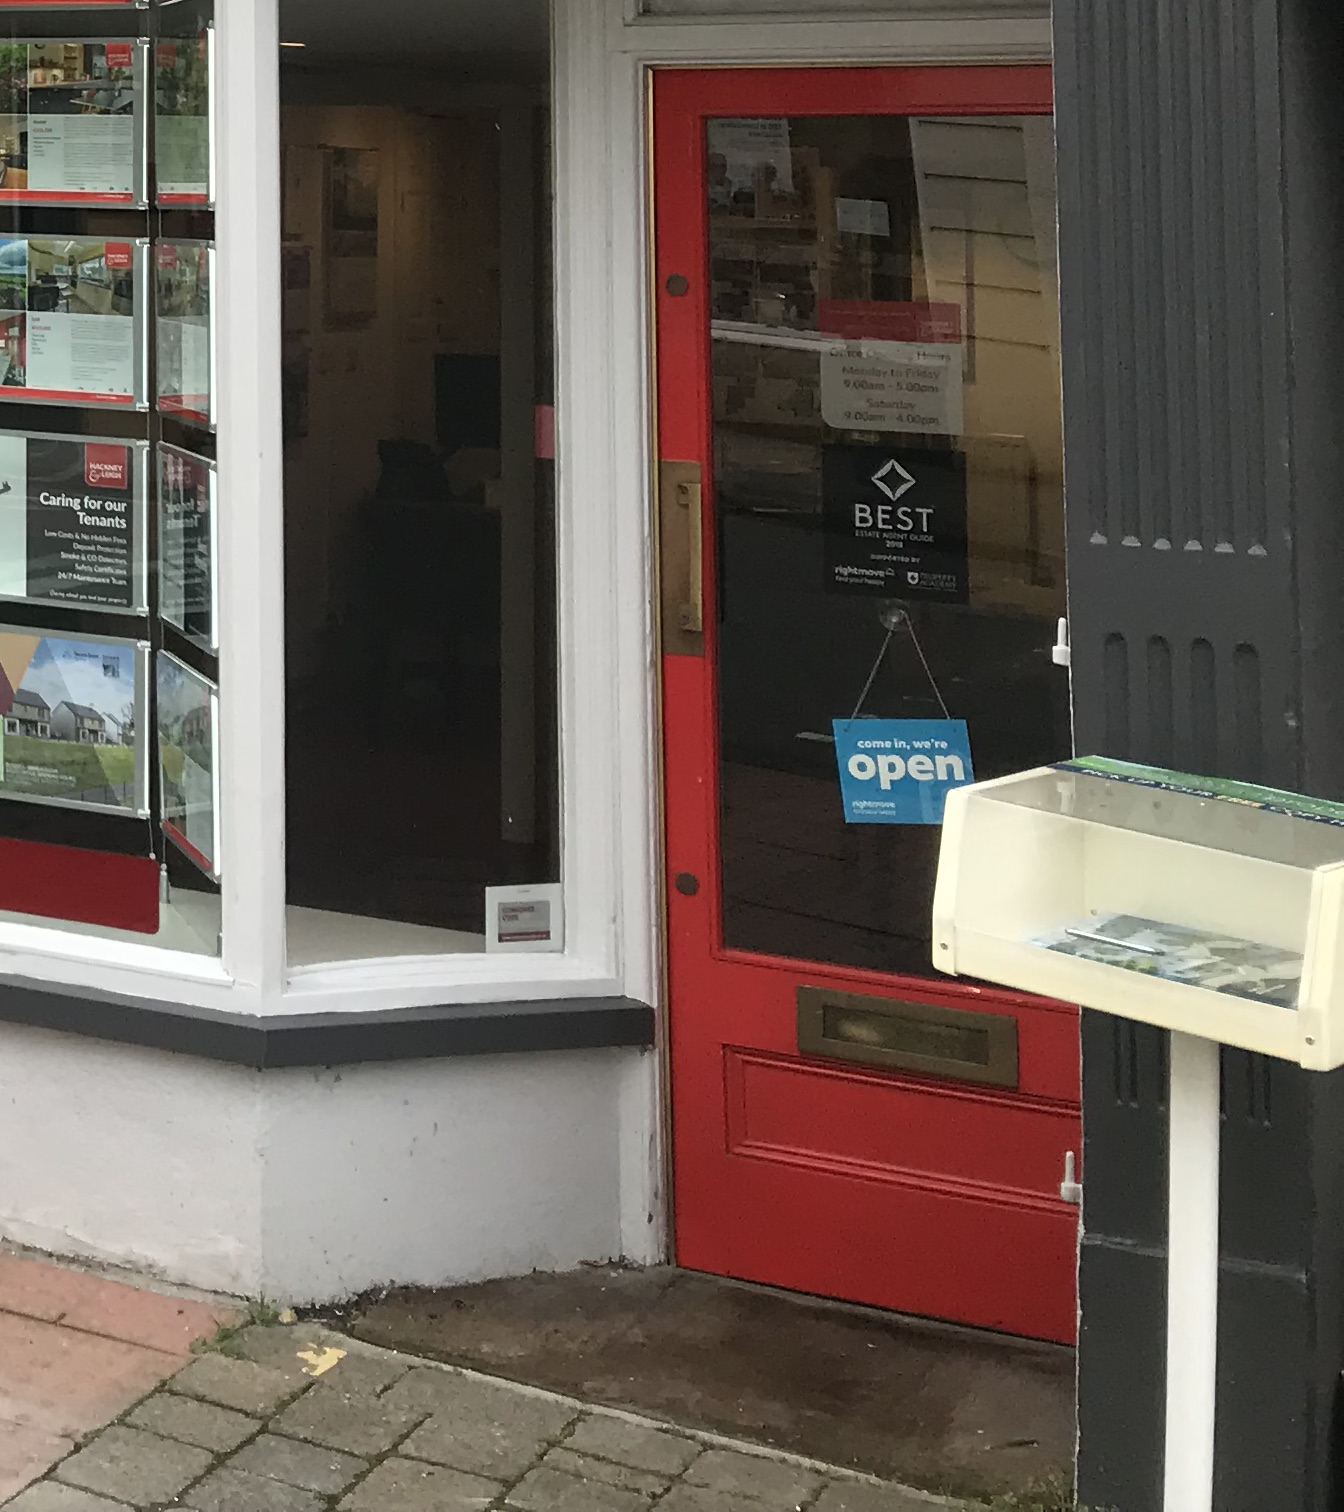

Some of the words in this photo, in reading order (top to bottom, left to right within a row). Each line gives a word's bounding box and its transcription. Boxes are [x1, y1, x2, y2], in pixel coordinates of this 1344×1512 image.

[90, 462, 123, 471] HACKNEY
[40, 492, 81, 510] Caring
[84, 496, 104, 510] for
[107, 500, 127, 512] our
[77, 511, 127, 529] Tenants
[855, 503, 934, 532] BEST
[87, 554, 97, 562] CO
[835, 564, 885, 577] rightmove
[857, 740, 892, 749] come
[894, 738, 910, 750] in,
[912, 739, 948, 749] we're
[848, 753, 965, 790] open
